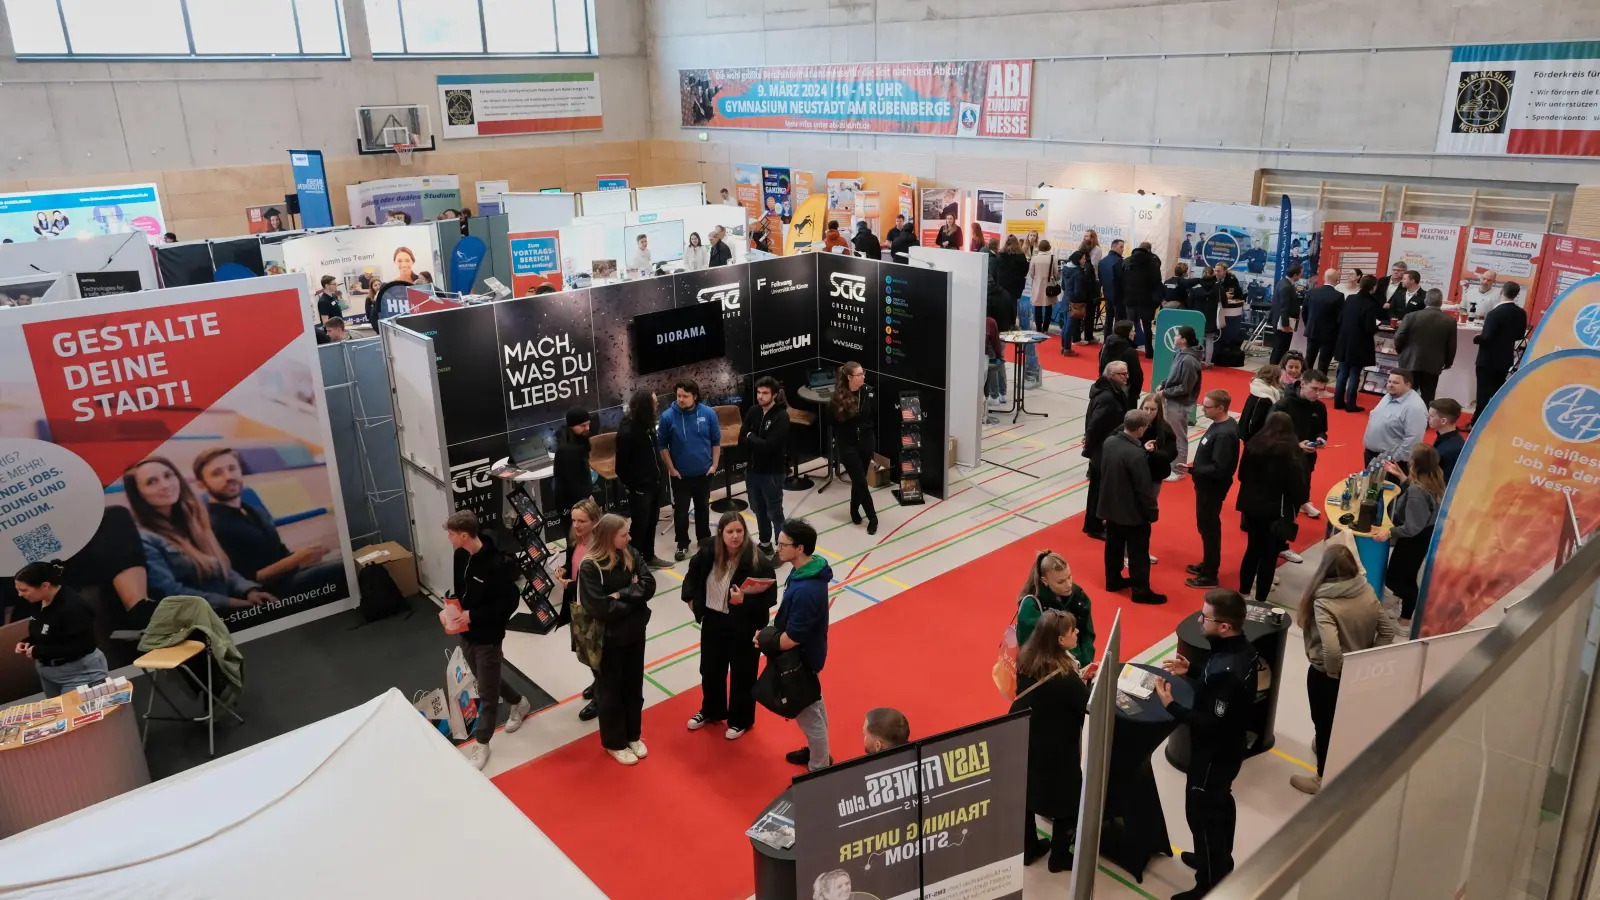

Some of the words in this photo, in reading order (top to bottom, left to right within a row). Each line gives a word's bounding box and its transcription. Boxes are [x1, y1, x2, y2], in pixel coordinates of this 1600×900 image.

[716, 72, 724, 80] Die
[726, 72, 740, 80] wohl
[742, 71, 761, 80] größte
[893, 66, 911, 76] nach
[914, 66, 931, 76] dem
[934, 66, 963, 75] Abitur!
[988, 64, 1028, 96] ABI
[1459, 71, 1513, 89] GYMNASIUM
[758, 85, 766, 96] 9.
[770, 82, 800, 96] MÄRZ
[802, 84, 827, 96] 2024
[836, 84, 848, 96] 10
[860, 84, 871, 96] 15
[876, 83, 902, 96] UHR
[726, 101, 787, 113] GYMNASIUM
[790, 101, 844, 114] NEUSTADT
[848, 101, 866, 114] AM
[870, 99, 950, 116] RÜBENBERGE
[987, 100, 1027, 112] ZUKUNFT
[986, 116, 1026, 134] MESSE
[1459, 121, 1500, 133] NEUSTADT
[1495, 240, 1537, 249] CHANCEN
[1497, 232, 1523, 240] DEINE
[354, 253, 375, 261] Team!
[513, 248, 554, 256] VORTRAGS-
[722, 311, 740, 319] TUTE
[832, 302, 864, 314] CREATIVE
[838, 313, 858, 322] MEDIA
[52, 312, 220, 358] GESTALTE
[656, 325, 706, 345] DIORAMA
[831, 321, 866, 333] INSTITUTE
[504, 332, 575, 364] MACH,
[761, 339, 784, 350] University
[793, 334, 810, 348] UH
[761, 345, 792, 356] Hertfordshire
[64, 352, 168, 390] DEINE
[506, 360, 555, 386] WAS
[562, 352, 592, 376] DU
[72, 380, 192, 422] STADT!
[509, 376, 588, 410] LIEBST!
[0, 452, 20, 468] RIG?
[1512, 436, 1540, 452] Der
[1544, 444, 1600, 468] heißes
[7, 458, 47, 479] MEHR!
[1514, 455, 1544, 470] Job
[1548, 464, 1567, 476] an
[1572, 470, 1600, 484] der
[0, 482, 27, 500] NDE
[28, 468, 63, 486] JOBS.
[1530, 474, 1579, 496] Weser
[0, 493, 38, 515] DUNG
[39, 480, 66, 497] UND
[455, 493, 492, 508] EATIVE
[0, 503, 54, 532] TUDIUM.
